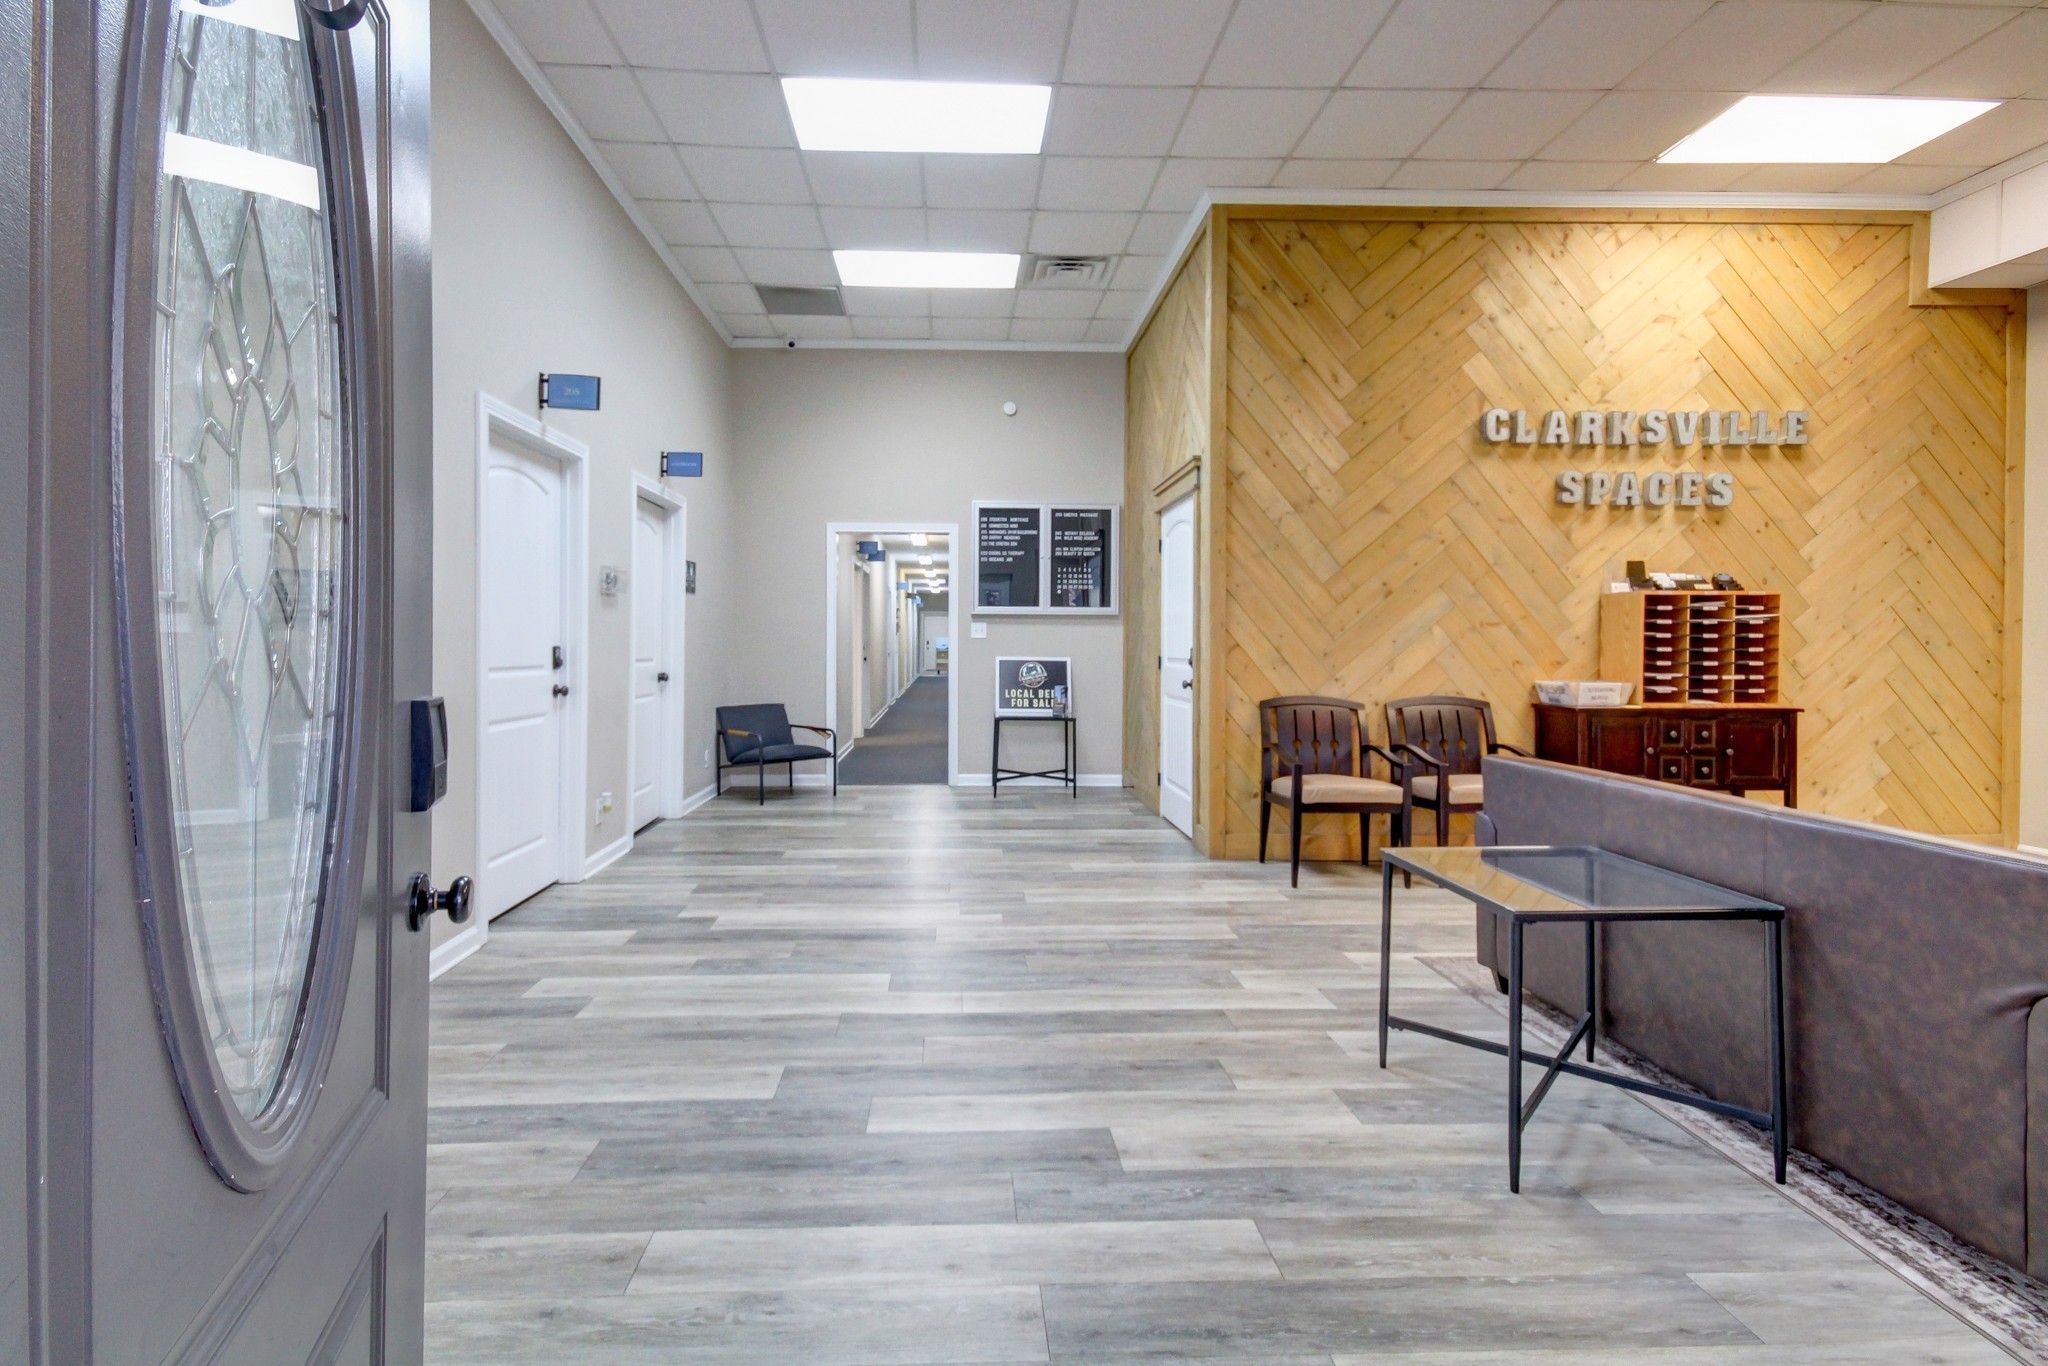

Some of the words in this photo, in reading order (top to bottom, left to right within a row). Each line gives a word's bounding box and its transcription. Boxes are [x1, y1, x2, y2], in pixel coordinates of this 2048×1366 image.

[1482, 408, 1809, 446] CLARKSVILLE
[1556, 470, 1734, 507] SPACES
[1005, 689, 1035, 698] LOCAL
[1011, 699, 1029, 708] FOR
